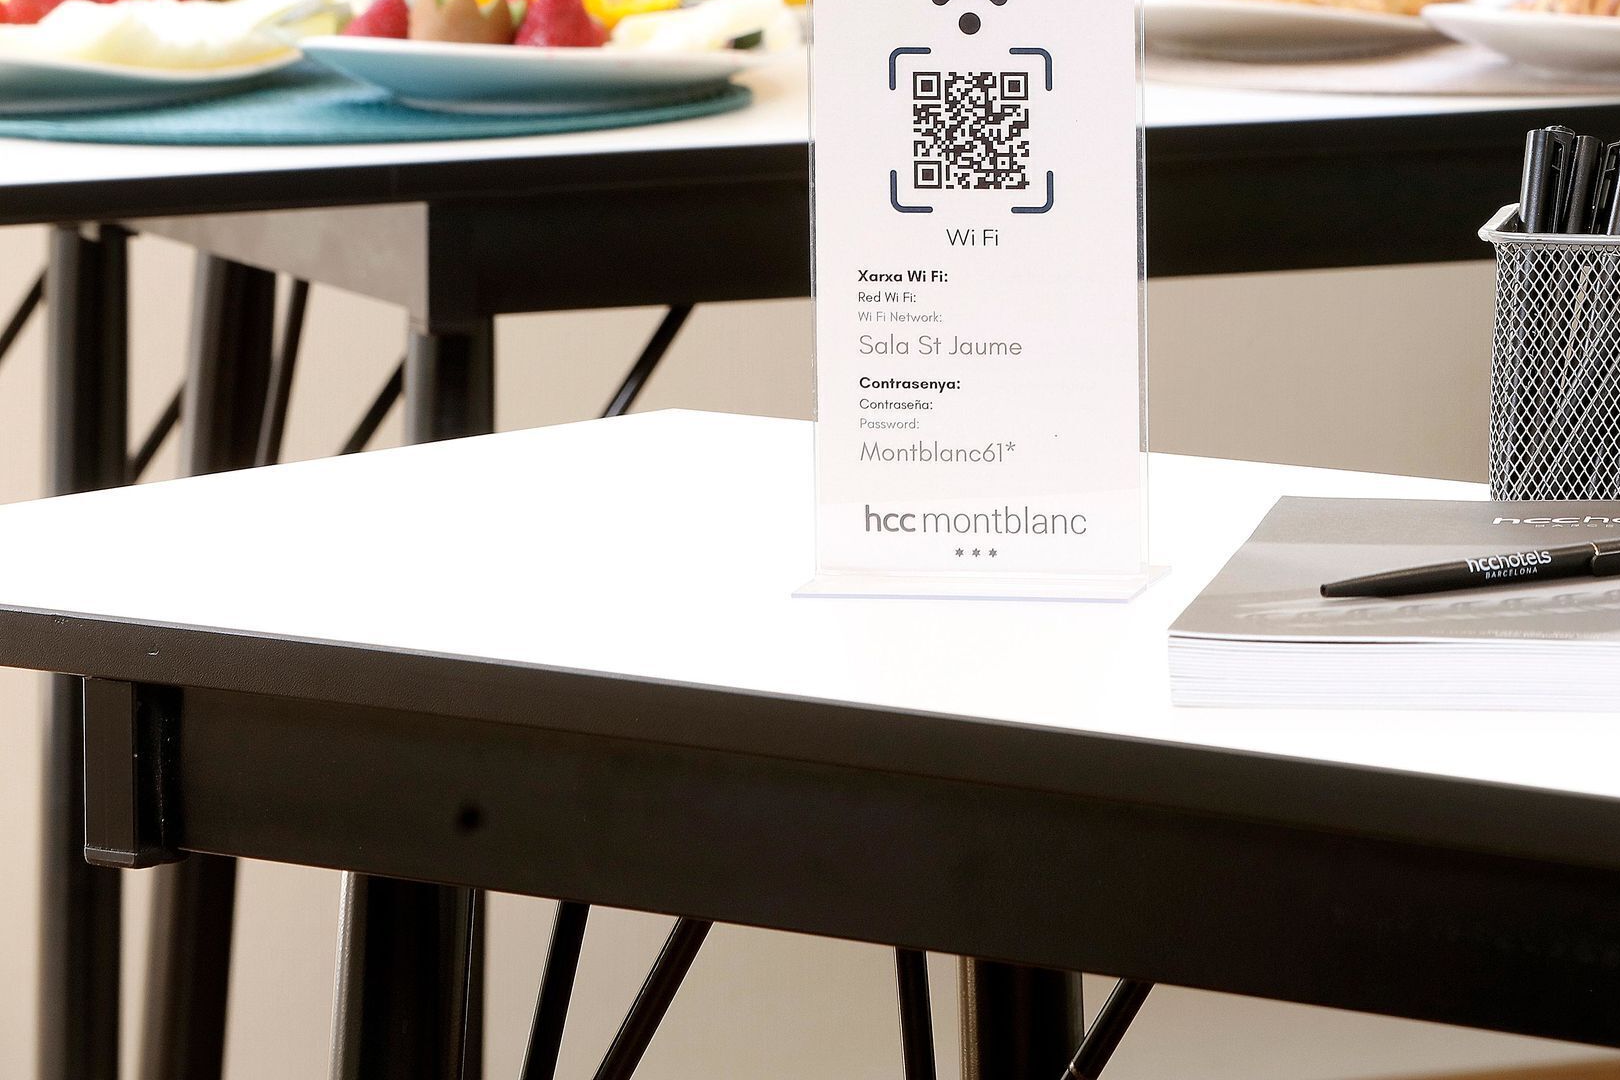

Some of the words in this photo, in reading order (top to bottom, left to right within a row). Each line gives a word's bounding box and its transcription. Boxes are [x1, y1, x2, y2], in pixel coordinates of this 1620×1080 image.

[946, 228, 976, 247] Wi
[982, 228, 1000, 247] Fi
[857, 269, 903, 283] Xarxa
[907, 269, 929, 284] Wi
[931, 270, 949, 284] Fi:
[857, 291, 882, 304] Red
[884, 291, 900, 304] Wi
[903, 292, 917, 304] Fi:
[857, 311, 873, 323] Wi
[876, 311, 887, 323] Fi
[890, 311, 943, 324] Network:
[858, 333, 910, 357] Sala
[917, 334, 942, 357] St
[948, 335, 1023, 357] Jaume
[858, 376, 961, 394] Contrasenya:
[858, 398, 934, 411] Contraseña:
[858, 417, 921, 430] Password:
[864, 504, 917, 533] hcc
[921, 505, 1088, 536] montblanc
[1465, 550, 1552, 573] hcchotels
[1485, 566, 1539, 580] BARCELONA
